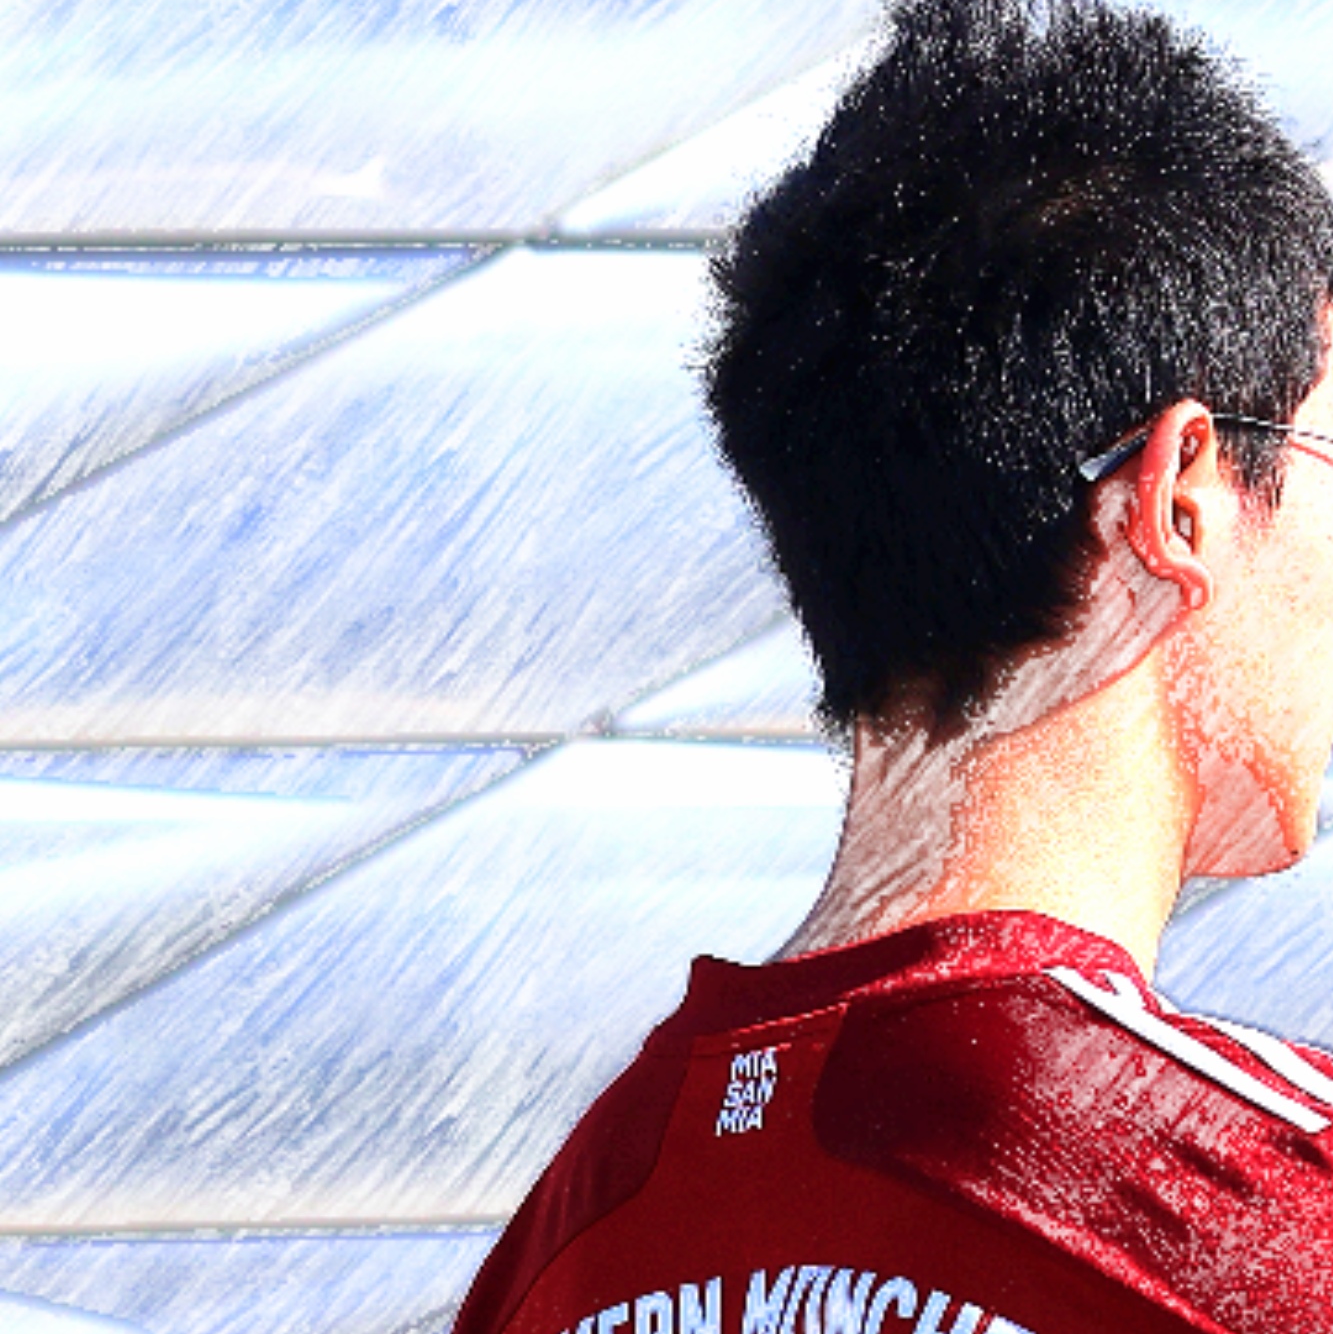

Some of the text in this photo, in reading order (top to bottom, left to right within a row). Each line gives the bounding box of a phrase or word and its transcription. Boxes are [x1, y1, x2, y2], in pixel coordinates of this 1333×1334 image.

[730, 1046, 778, 1082] MIA
[723, 1075, 776, 1108] SAN
[715, 1104, 763, 1137] MIA
